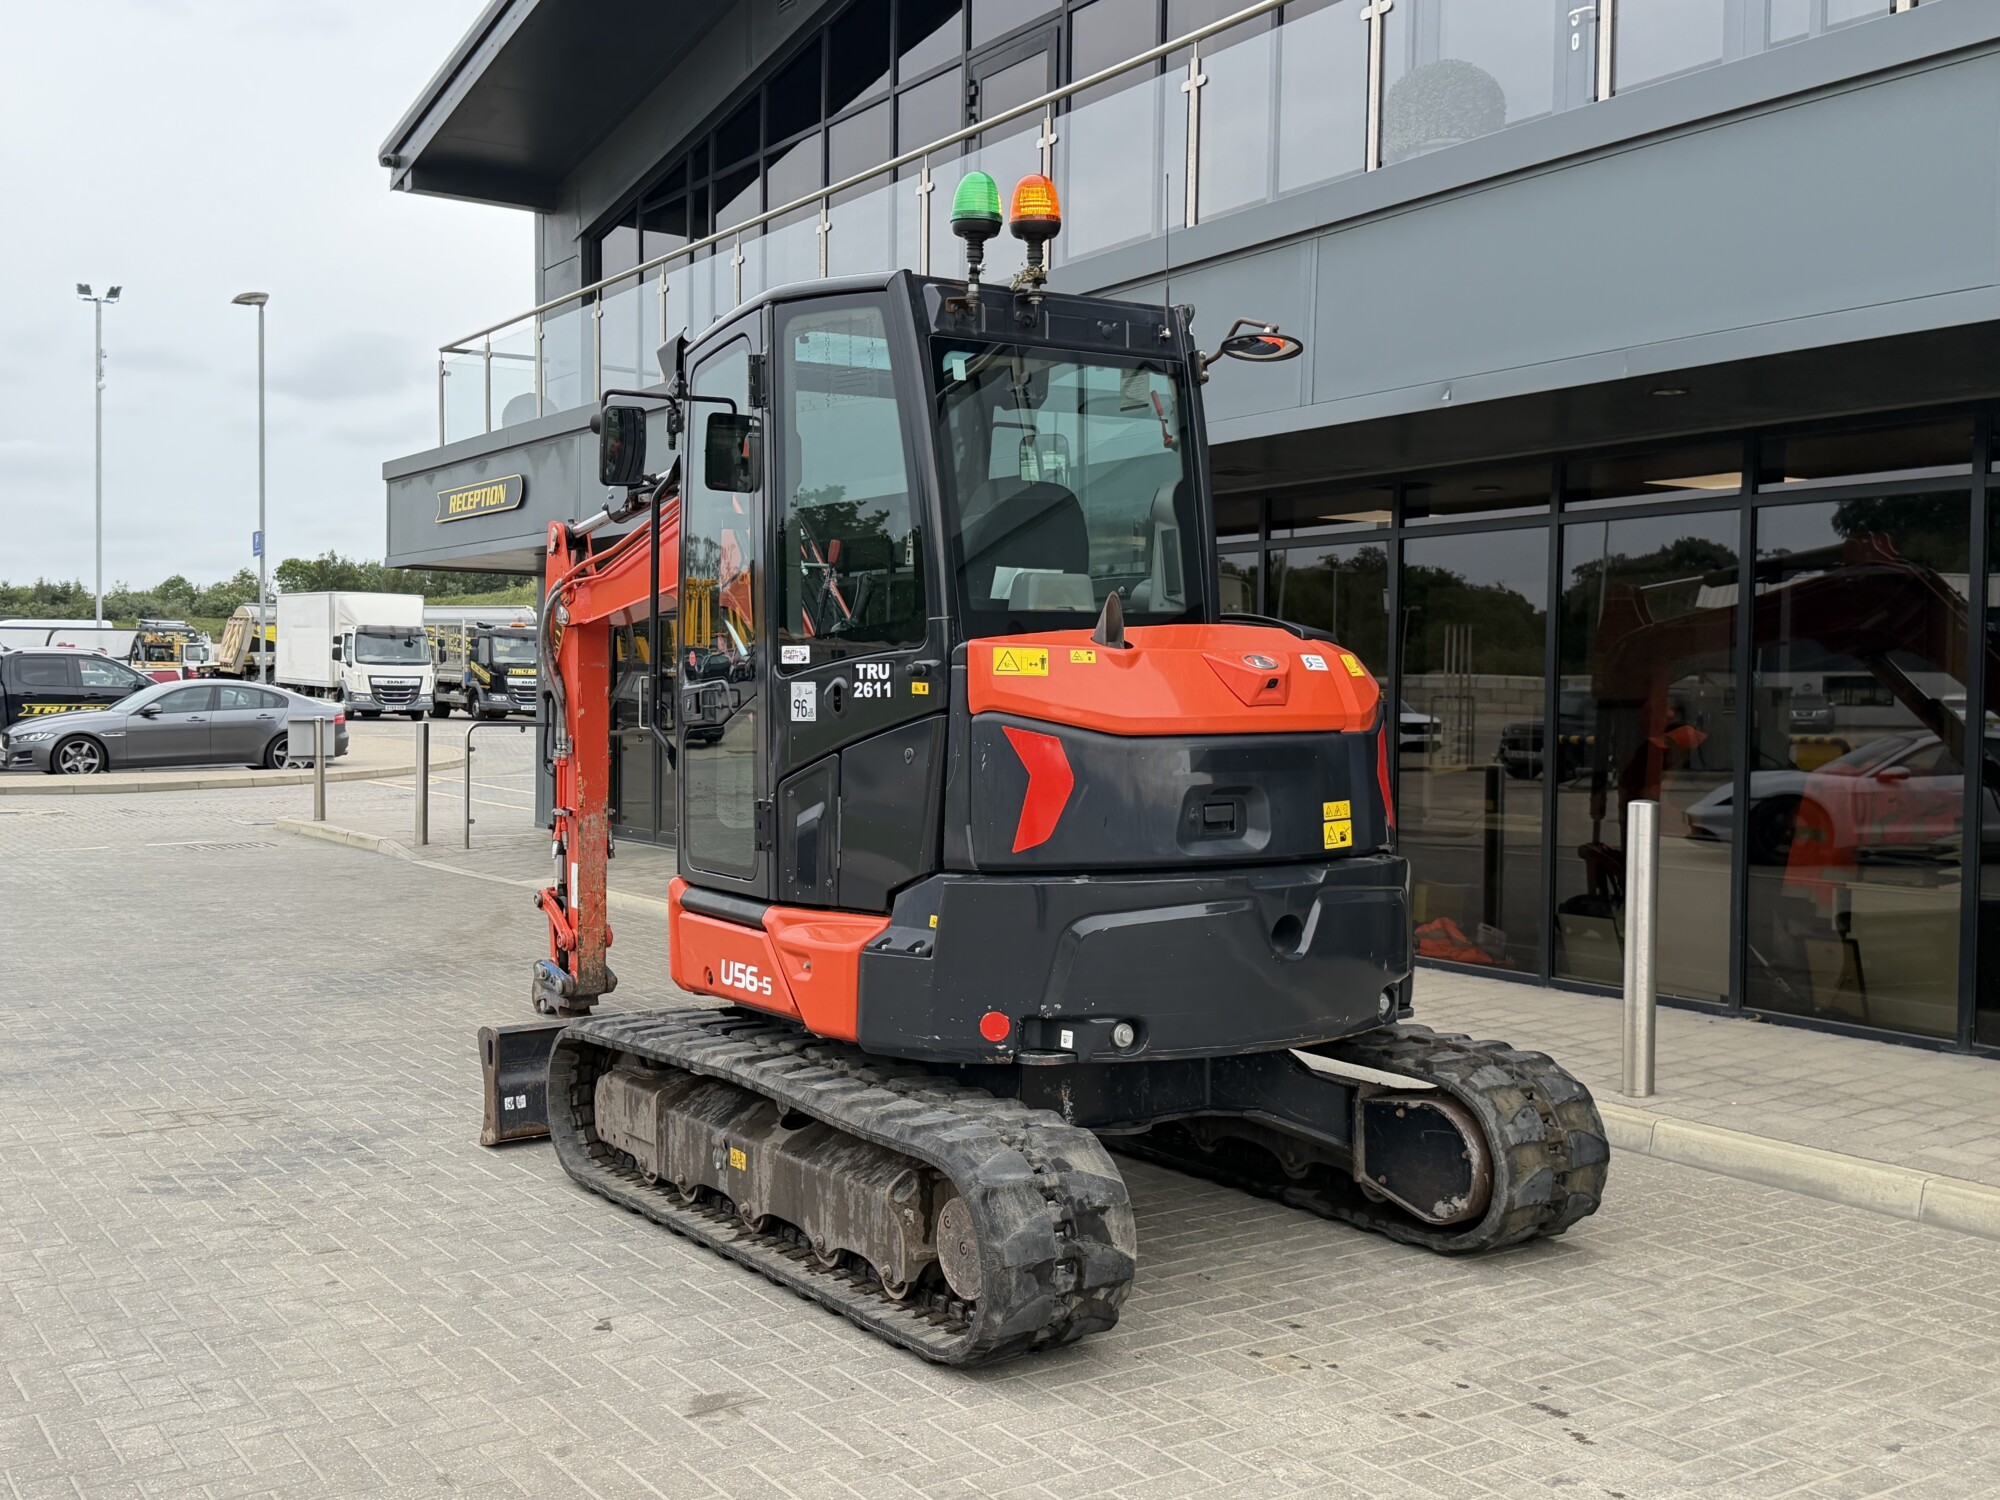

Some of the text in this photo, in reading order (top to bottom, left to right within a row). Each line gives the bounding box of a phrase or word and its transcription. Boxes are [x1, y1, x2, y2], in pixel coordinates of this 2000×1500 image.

[449, 483, 507, 514] RECEPTION
[855, 663, 890, 680] TRU
[853, 681, 892, 698] 2611
[793, 698, 808, 718] 96
[720, 958, 772, 996] U56-5
